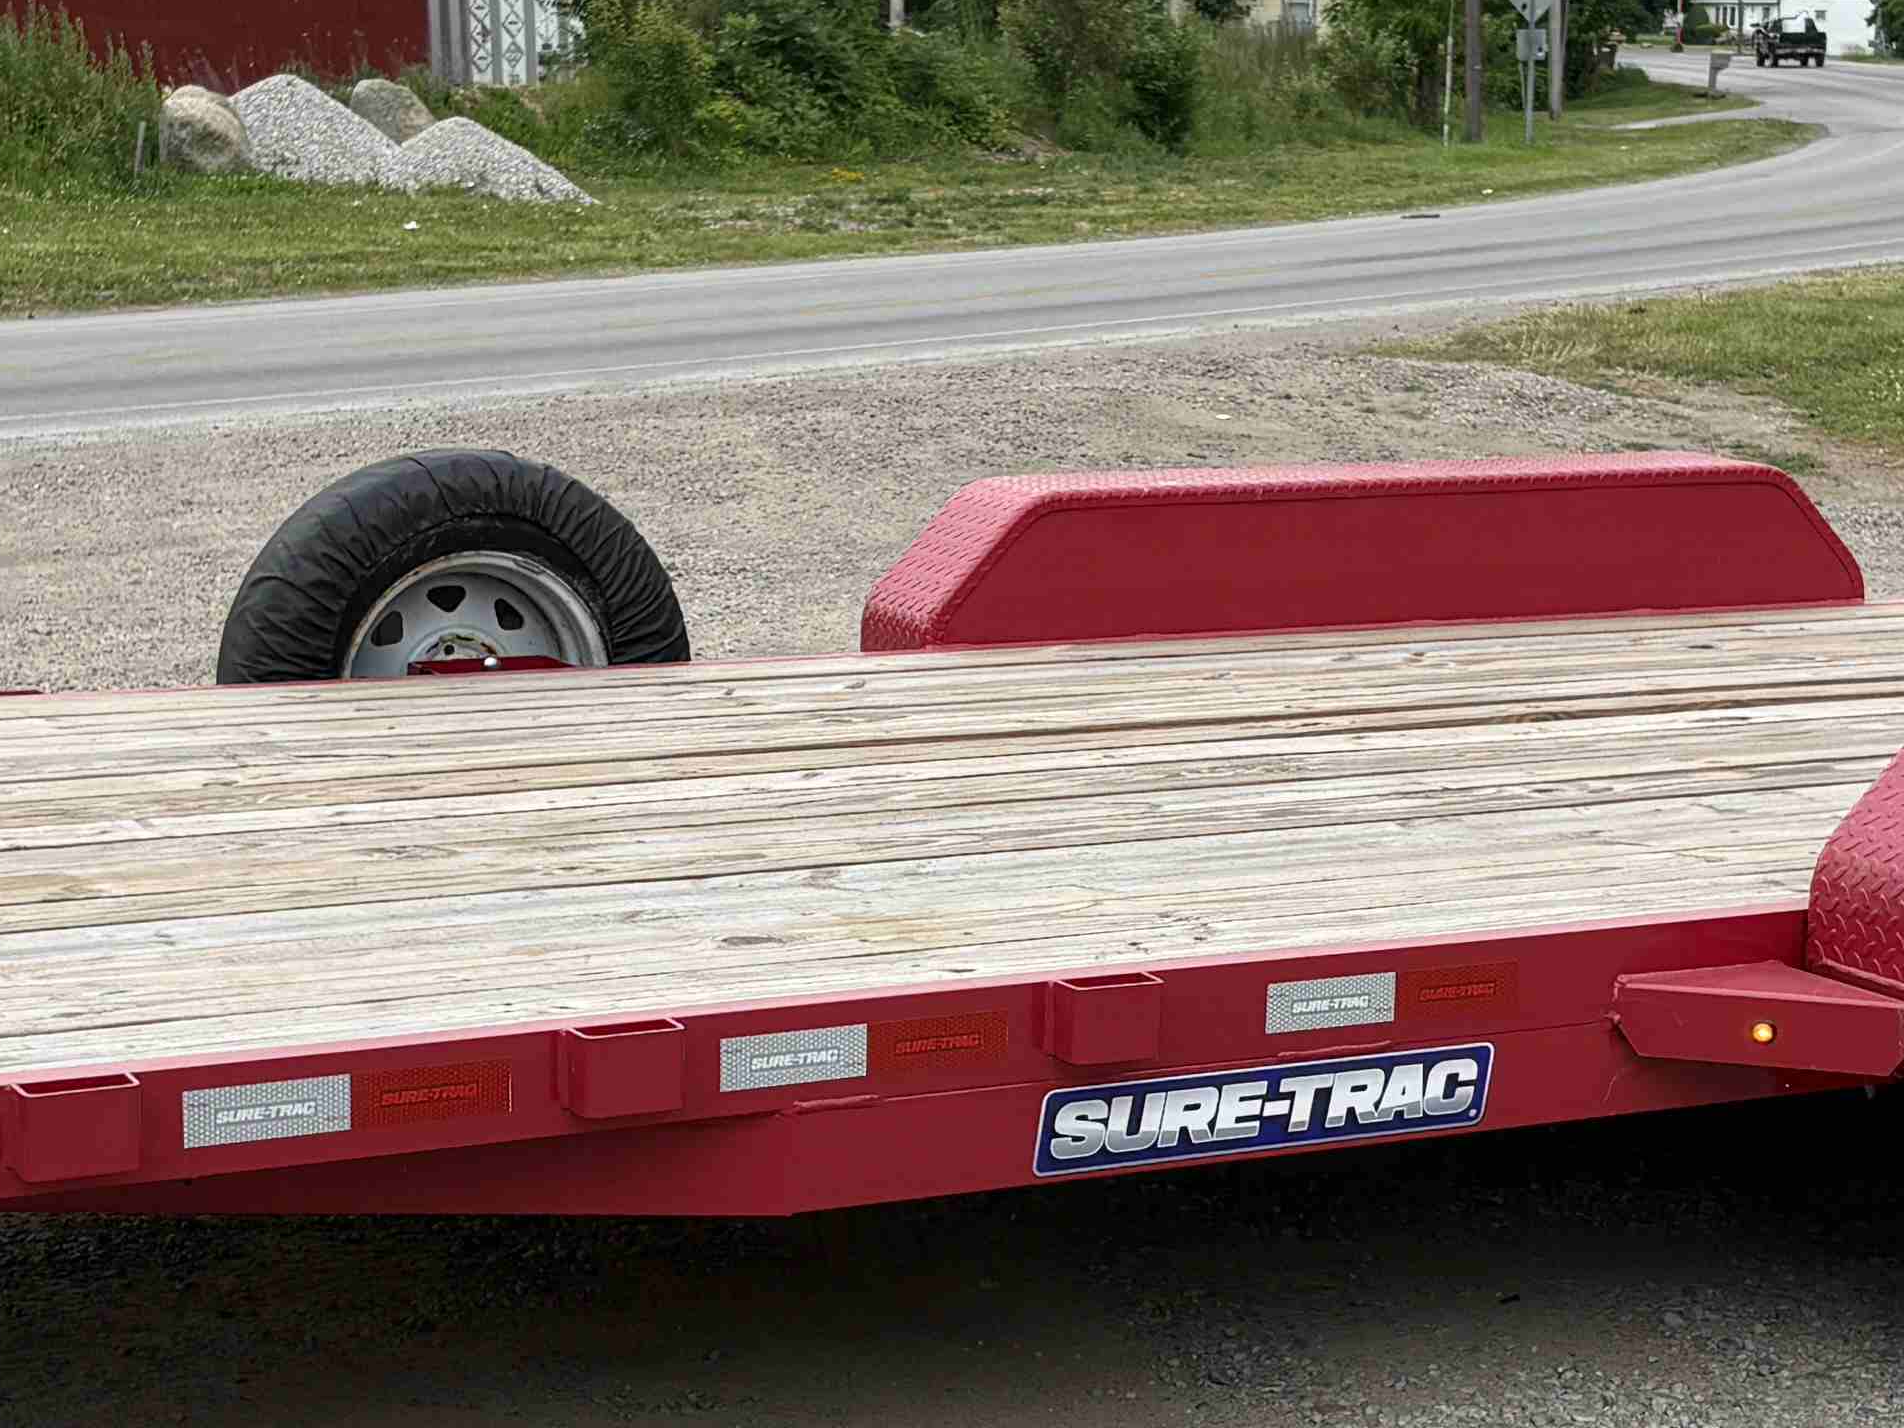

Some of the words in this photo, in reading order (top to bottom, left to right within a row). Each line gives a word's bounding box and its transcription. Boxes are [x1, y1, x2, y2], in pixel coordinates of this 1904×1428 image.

[1292, 994, 1370, 1014] SURE-TRAC
[751, 1048, 840, 1071] SURE-TRAC
[215, 1100, 317, 1126] SURE-TRAC
[1049, 1058, 1479, 1160] SURE-TRAC
